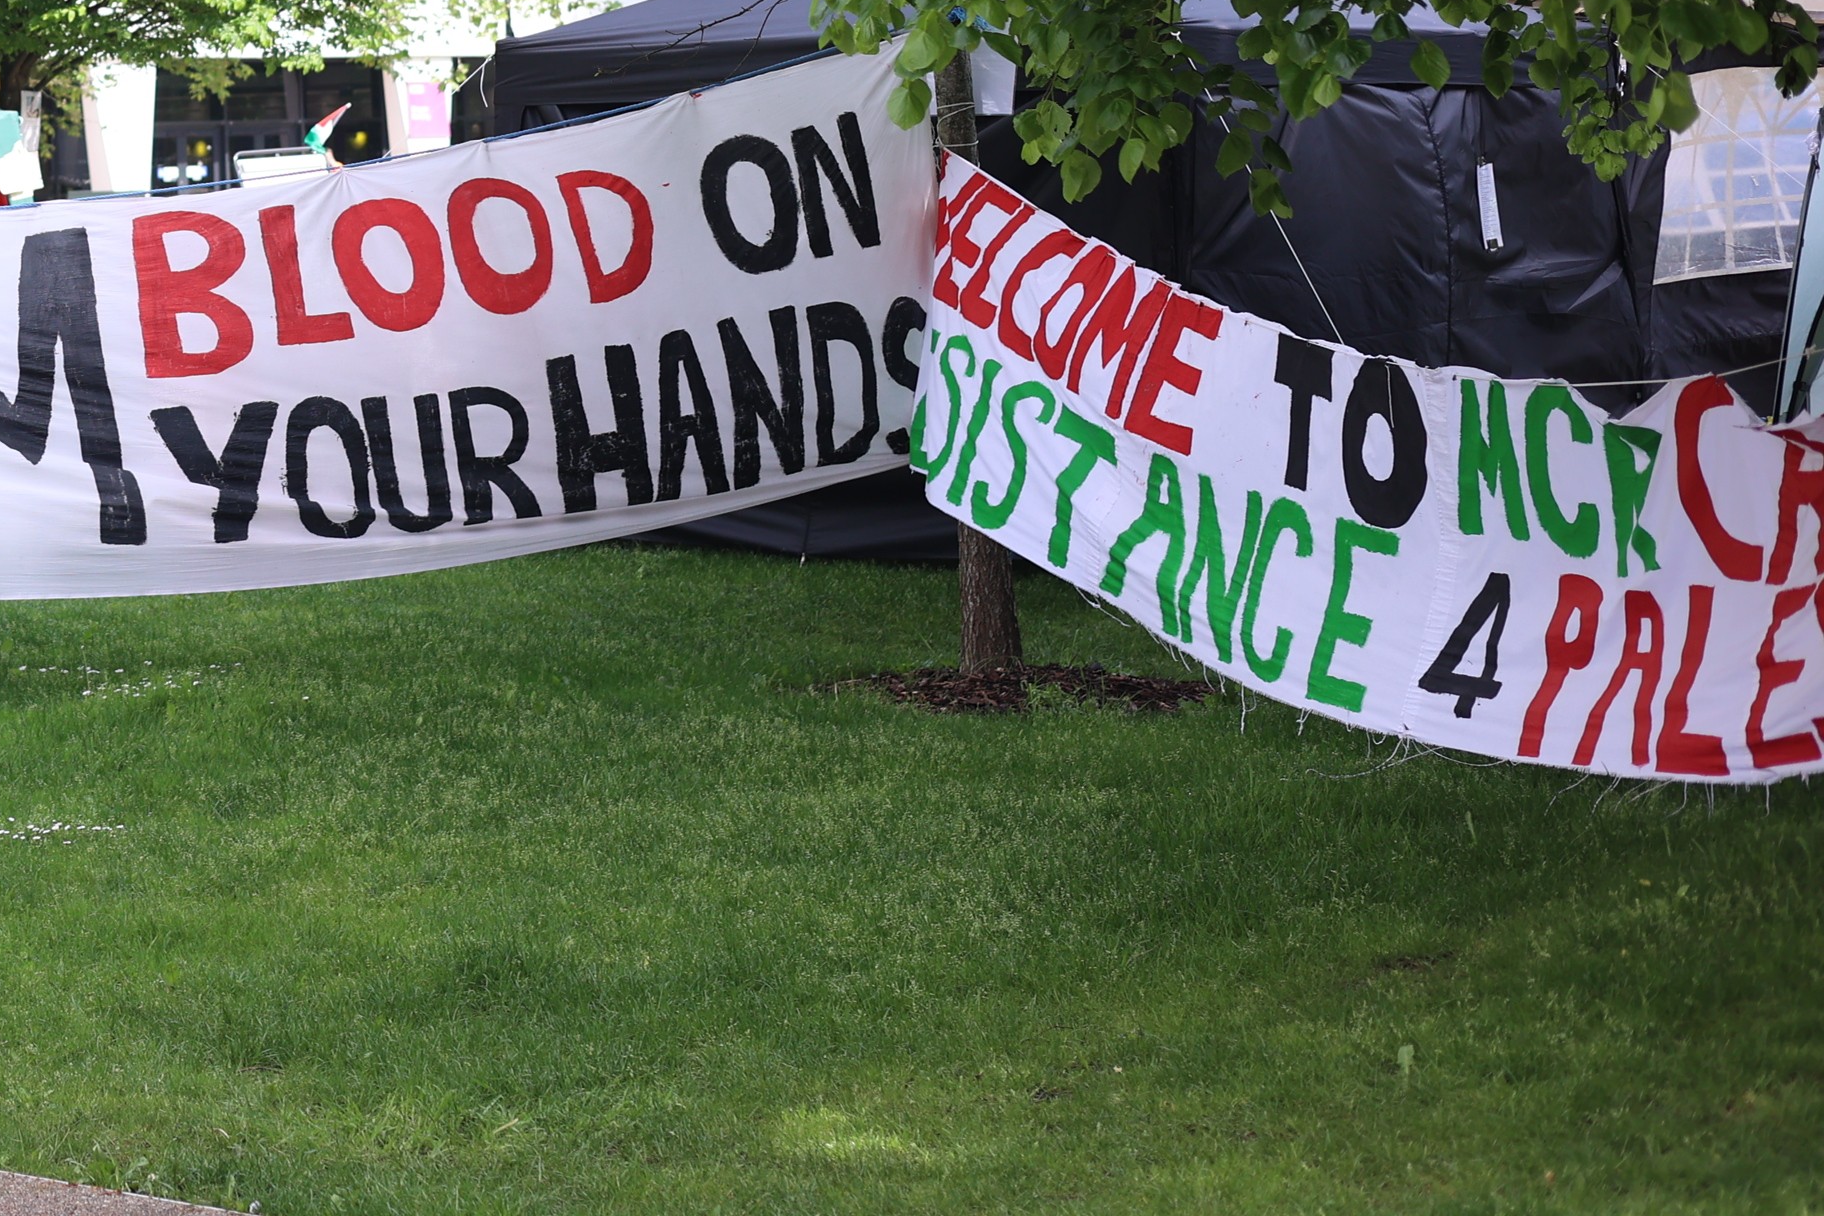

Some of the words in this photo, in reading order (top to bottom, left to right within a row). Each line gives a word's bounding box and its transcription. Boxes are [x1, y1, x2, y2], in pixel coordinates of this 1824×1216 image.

[132, 169, 655, 379] BLOOD
[700, 111, 881, 275] ON
[149, 385, 543, 544] YOUR
[545, 296, 928, 514] HANDS
[1274, 332, 1429, 530] TO
[1457, 377, 1662, 578] MCR
[909, 329, 1400, 714] SISTANCE
[1418, 571, 1512, 720] 4
[1517, 572, 1824, 776] PALE
